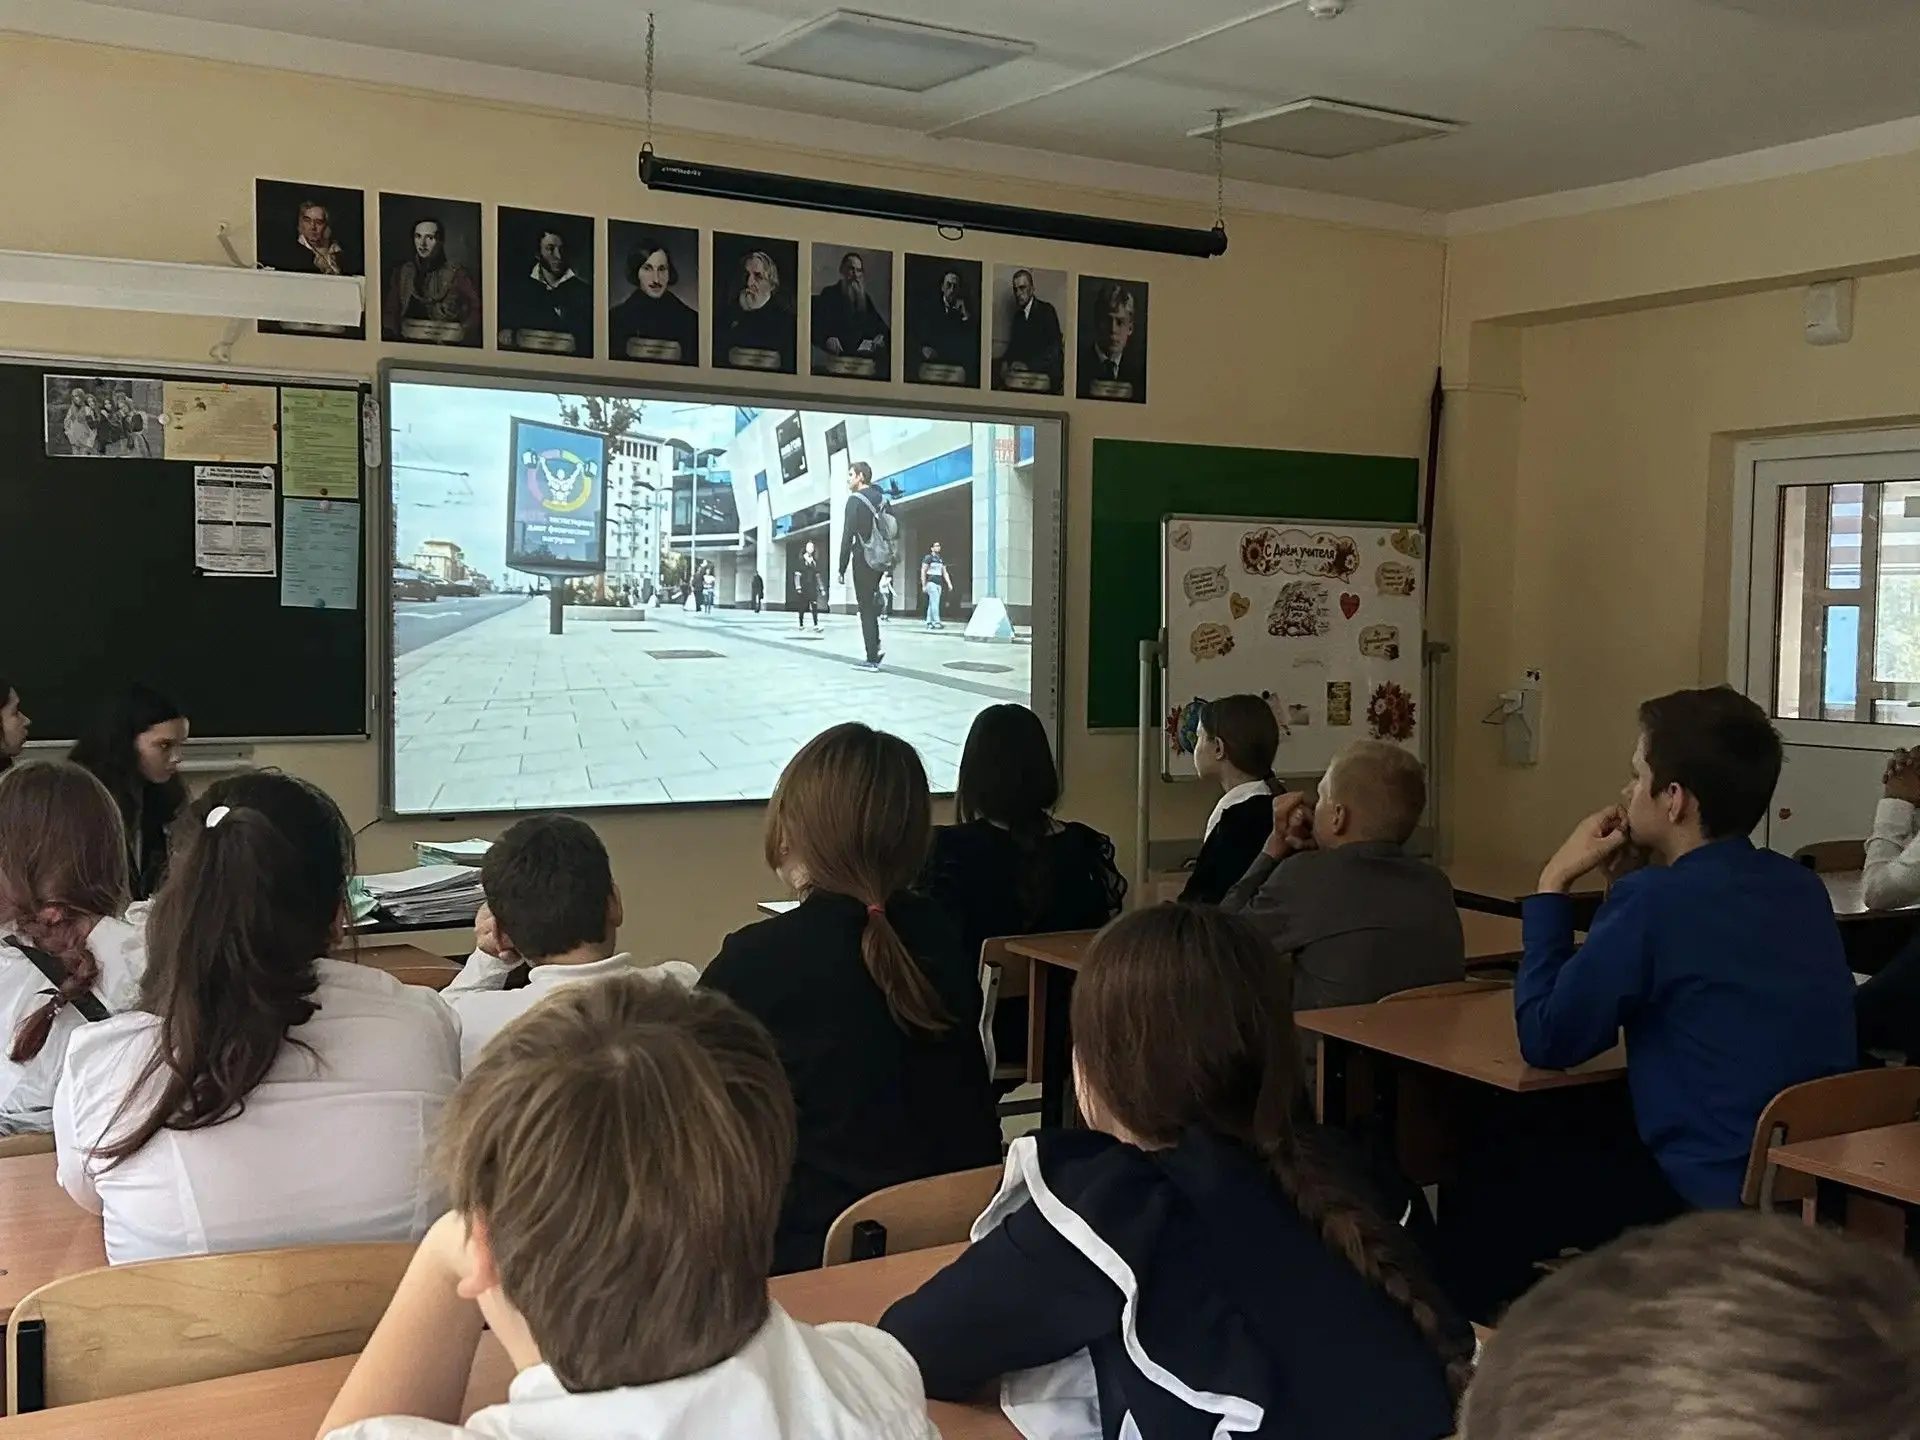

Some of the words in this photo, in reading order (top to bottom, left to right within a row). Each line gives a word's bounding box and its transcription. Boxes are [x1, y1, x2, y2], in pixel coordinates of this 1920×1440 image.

[1265, 544, 1272, 557] С
[1273, 543, 1298, 557] Днём
[1299, 547, 1335, 559] учителя
